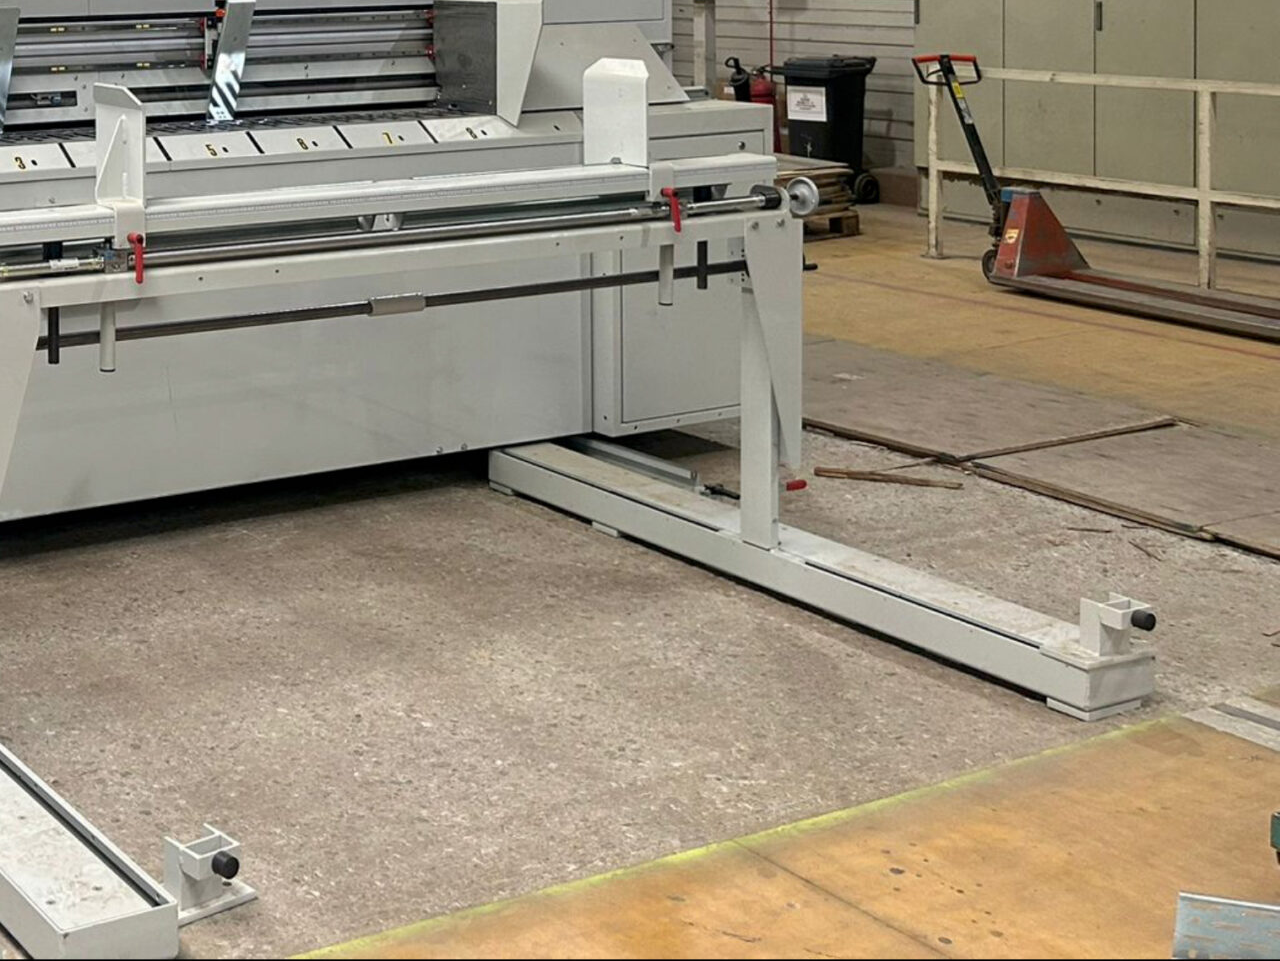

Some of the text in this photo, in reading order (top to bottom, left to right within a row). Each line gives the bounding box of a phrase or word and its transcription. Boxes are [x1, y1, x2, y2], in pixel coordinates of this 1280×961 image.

[14, 156, 27, 170] 3
[205, 143, 218, 157] 5
[381, 131, 393, 145] 7
